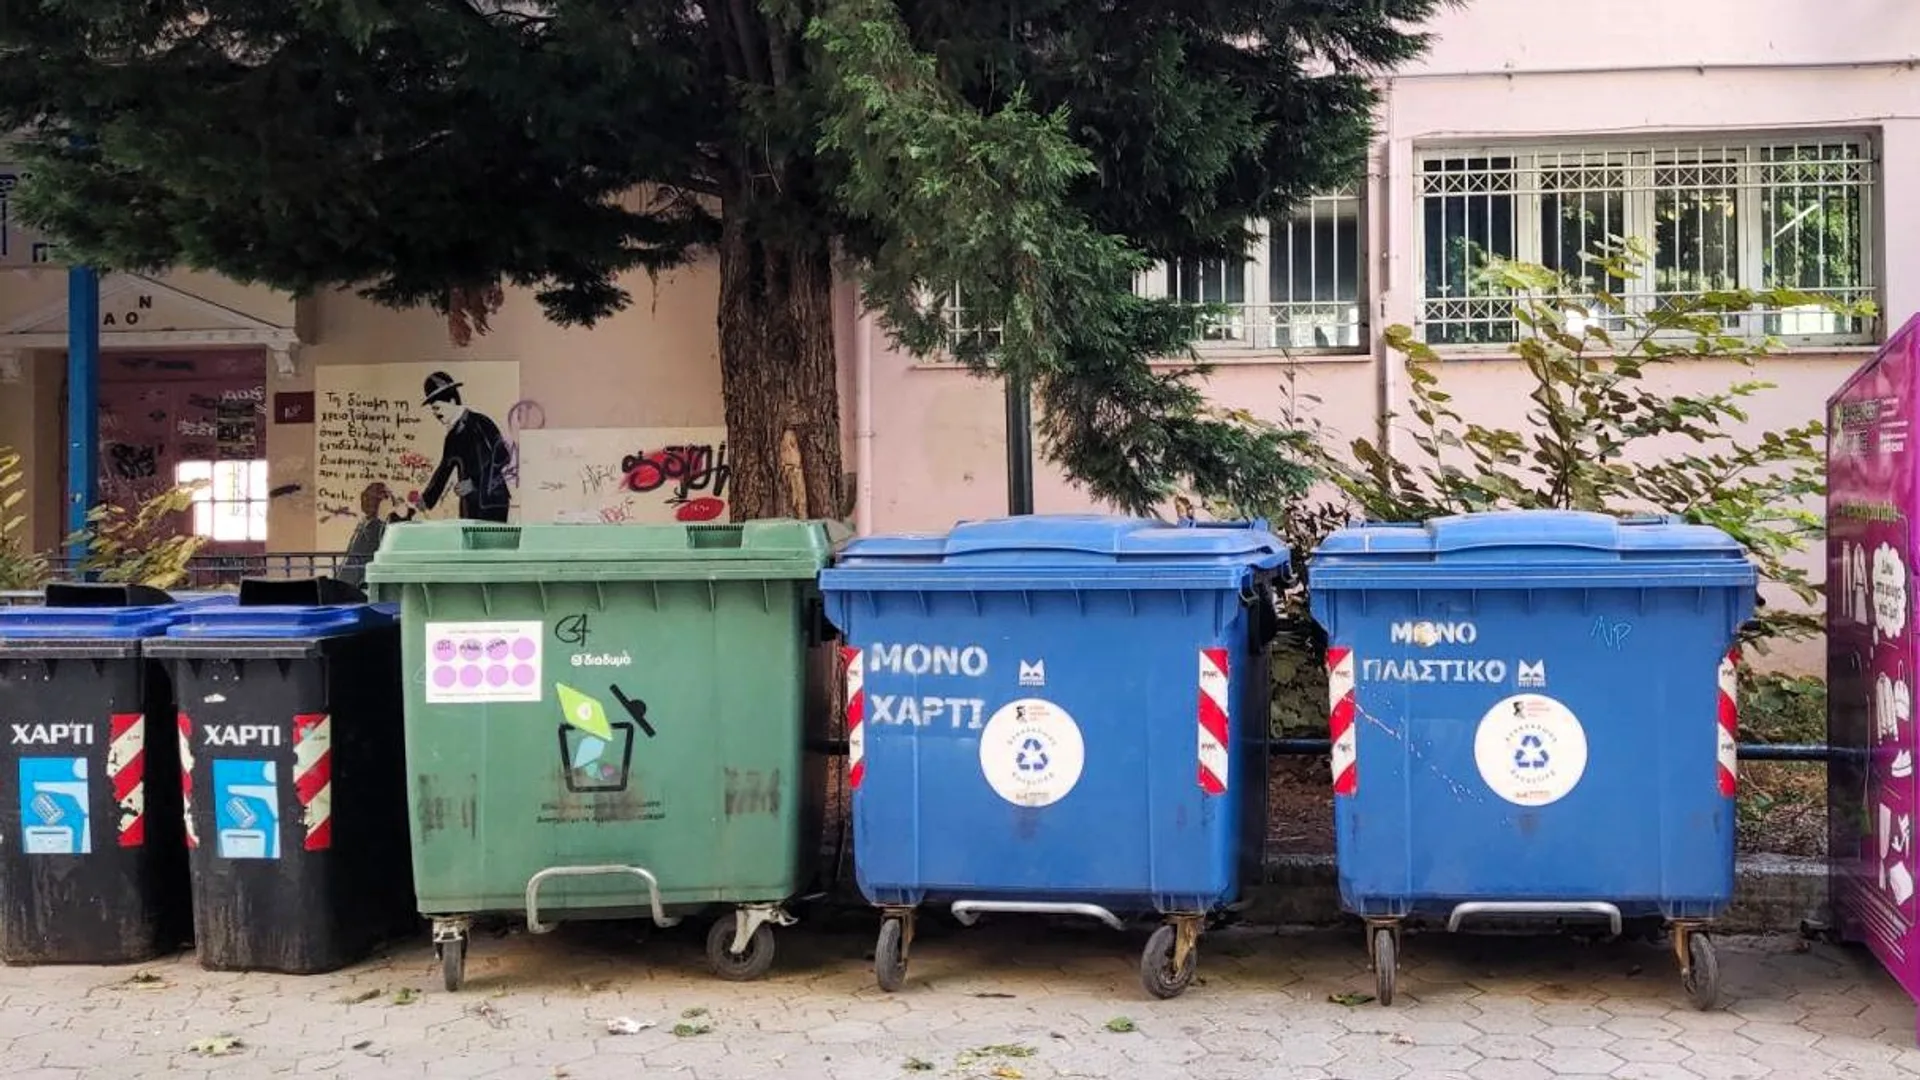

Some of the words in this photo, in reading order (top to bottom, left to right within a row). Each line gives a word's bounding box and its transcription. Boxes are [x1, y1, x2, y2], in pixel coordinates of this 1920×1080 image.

[870, 642, 988, 676] ΜΟΝΟ
[1362, 658, 1507, 683] ΠΛΑΣΤΙΚΟ
[870, 694, 985, 729] ΧΑΡΤΙ
[11, 722, 94, 745] ΧΑΡΤΙ
[203, 724, 281, 746] ΧΑΡΤΙ
